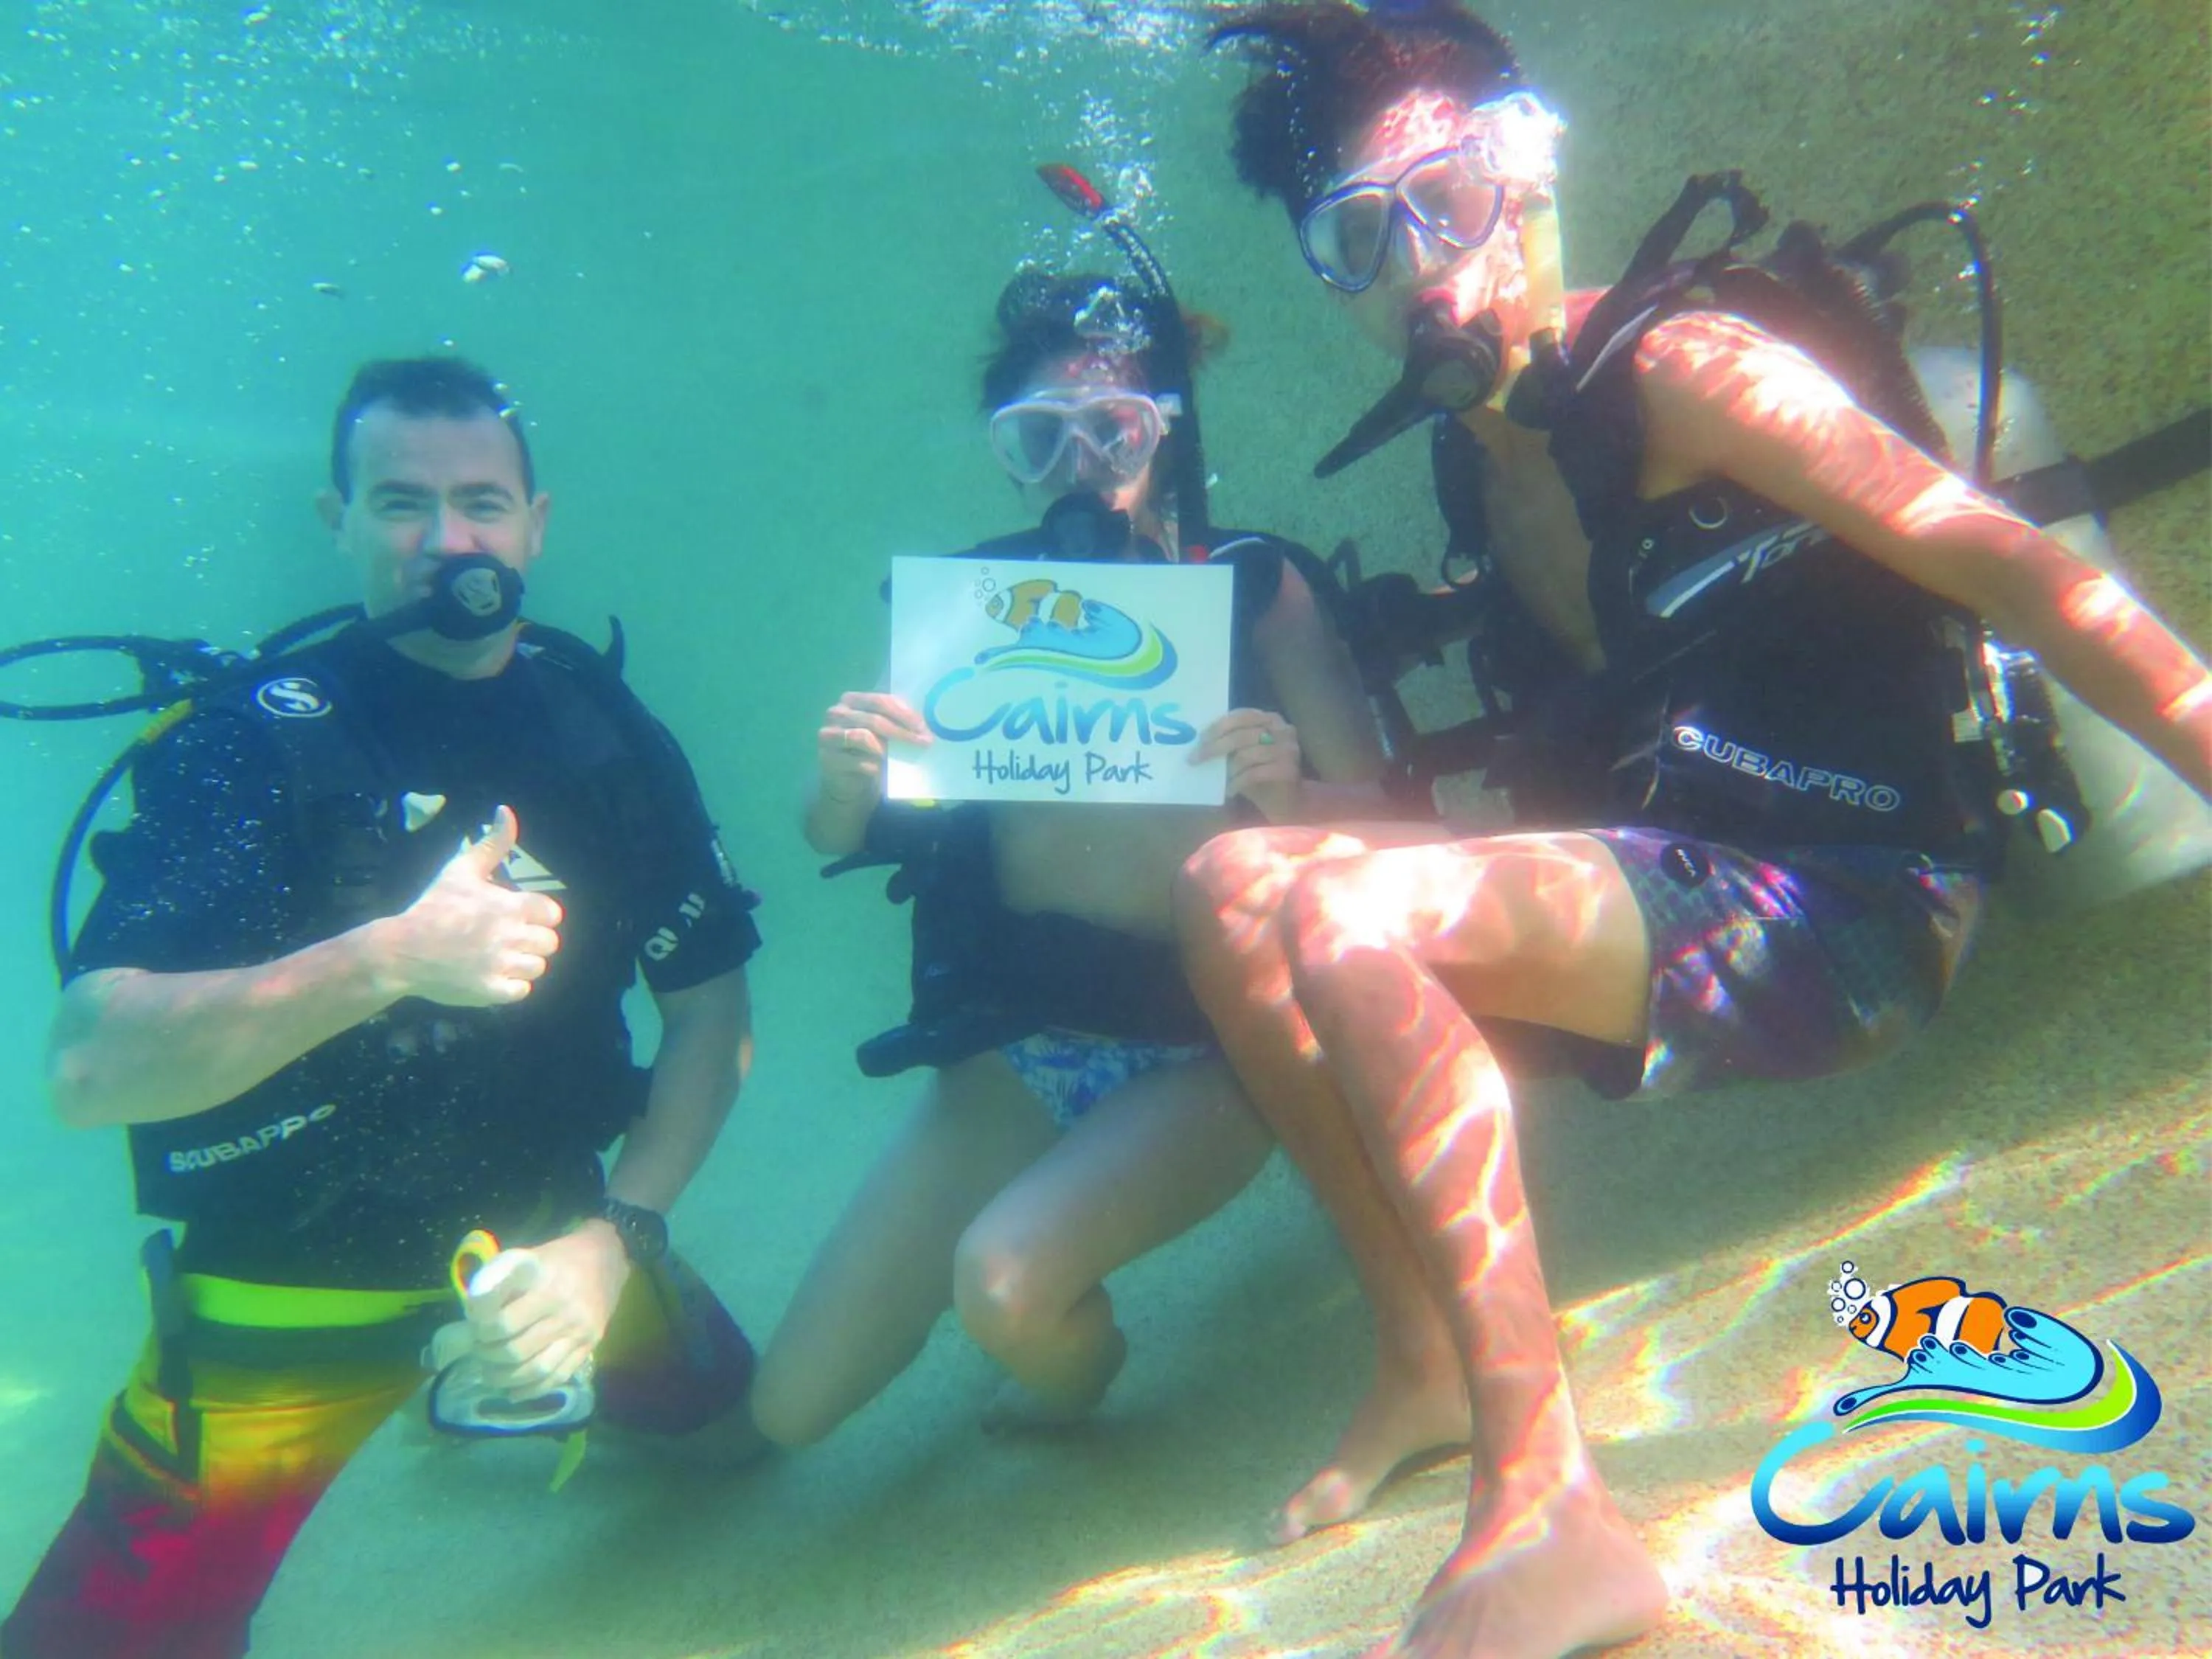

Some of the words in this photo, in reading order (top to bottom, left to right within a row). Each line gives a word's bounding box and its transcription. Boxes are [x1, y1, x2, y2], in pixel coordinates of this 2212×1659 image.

[924, 667, 1197, 745] Cairns
[973, 750, 1071, 794] Holiday
[1084, 751, 1153, 785] Park
[1670, 726, 1901, 812] CUBAPRO
